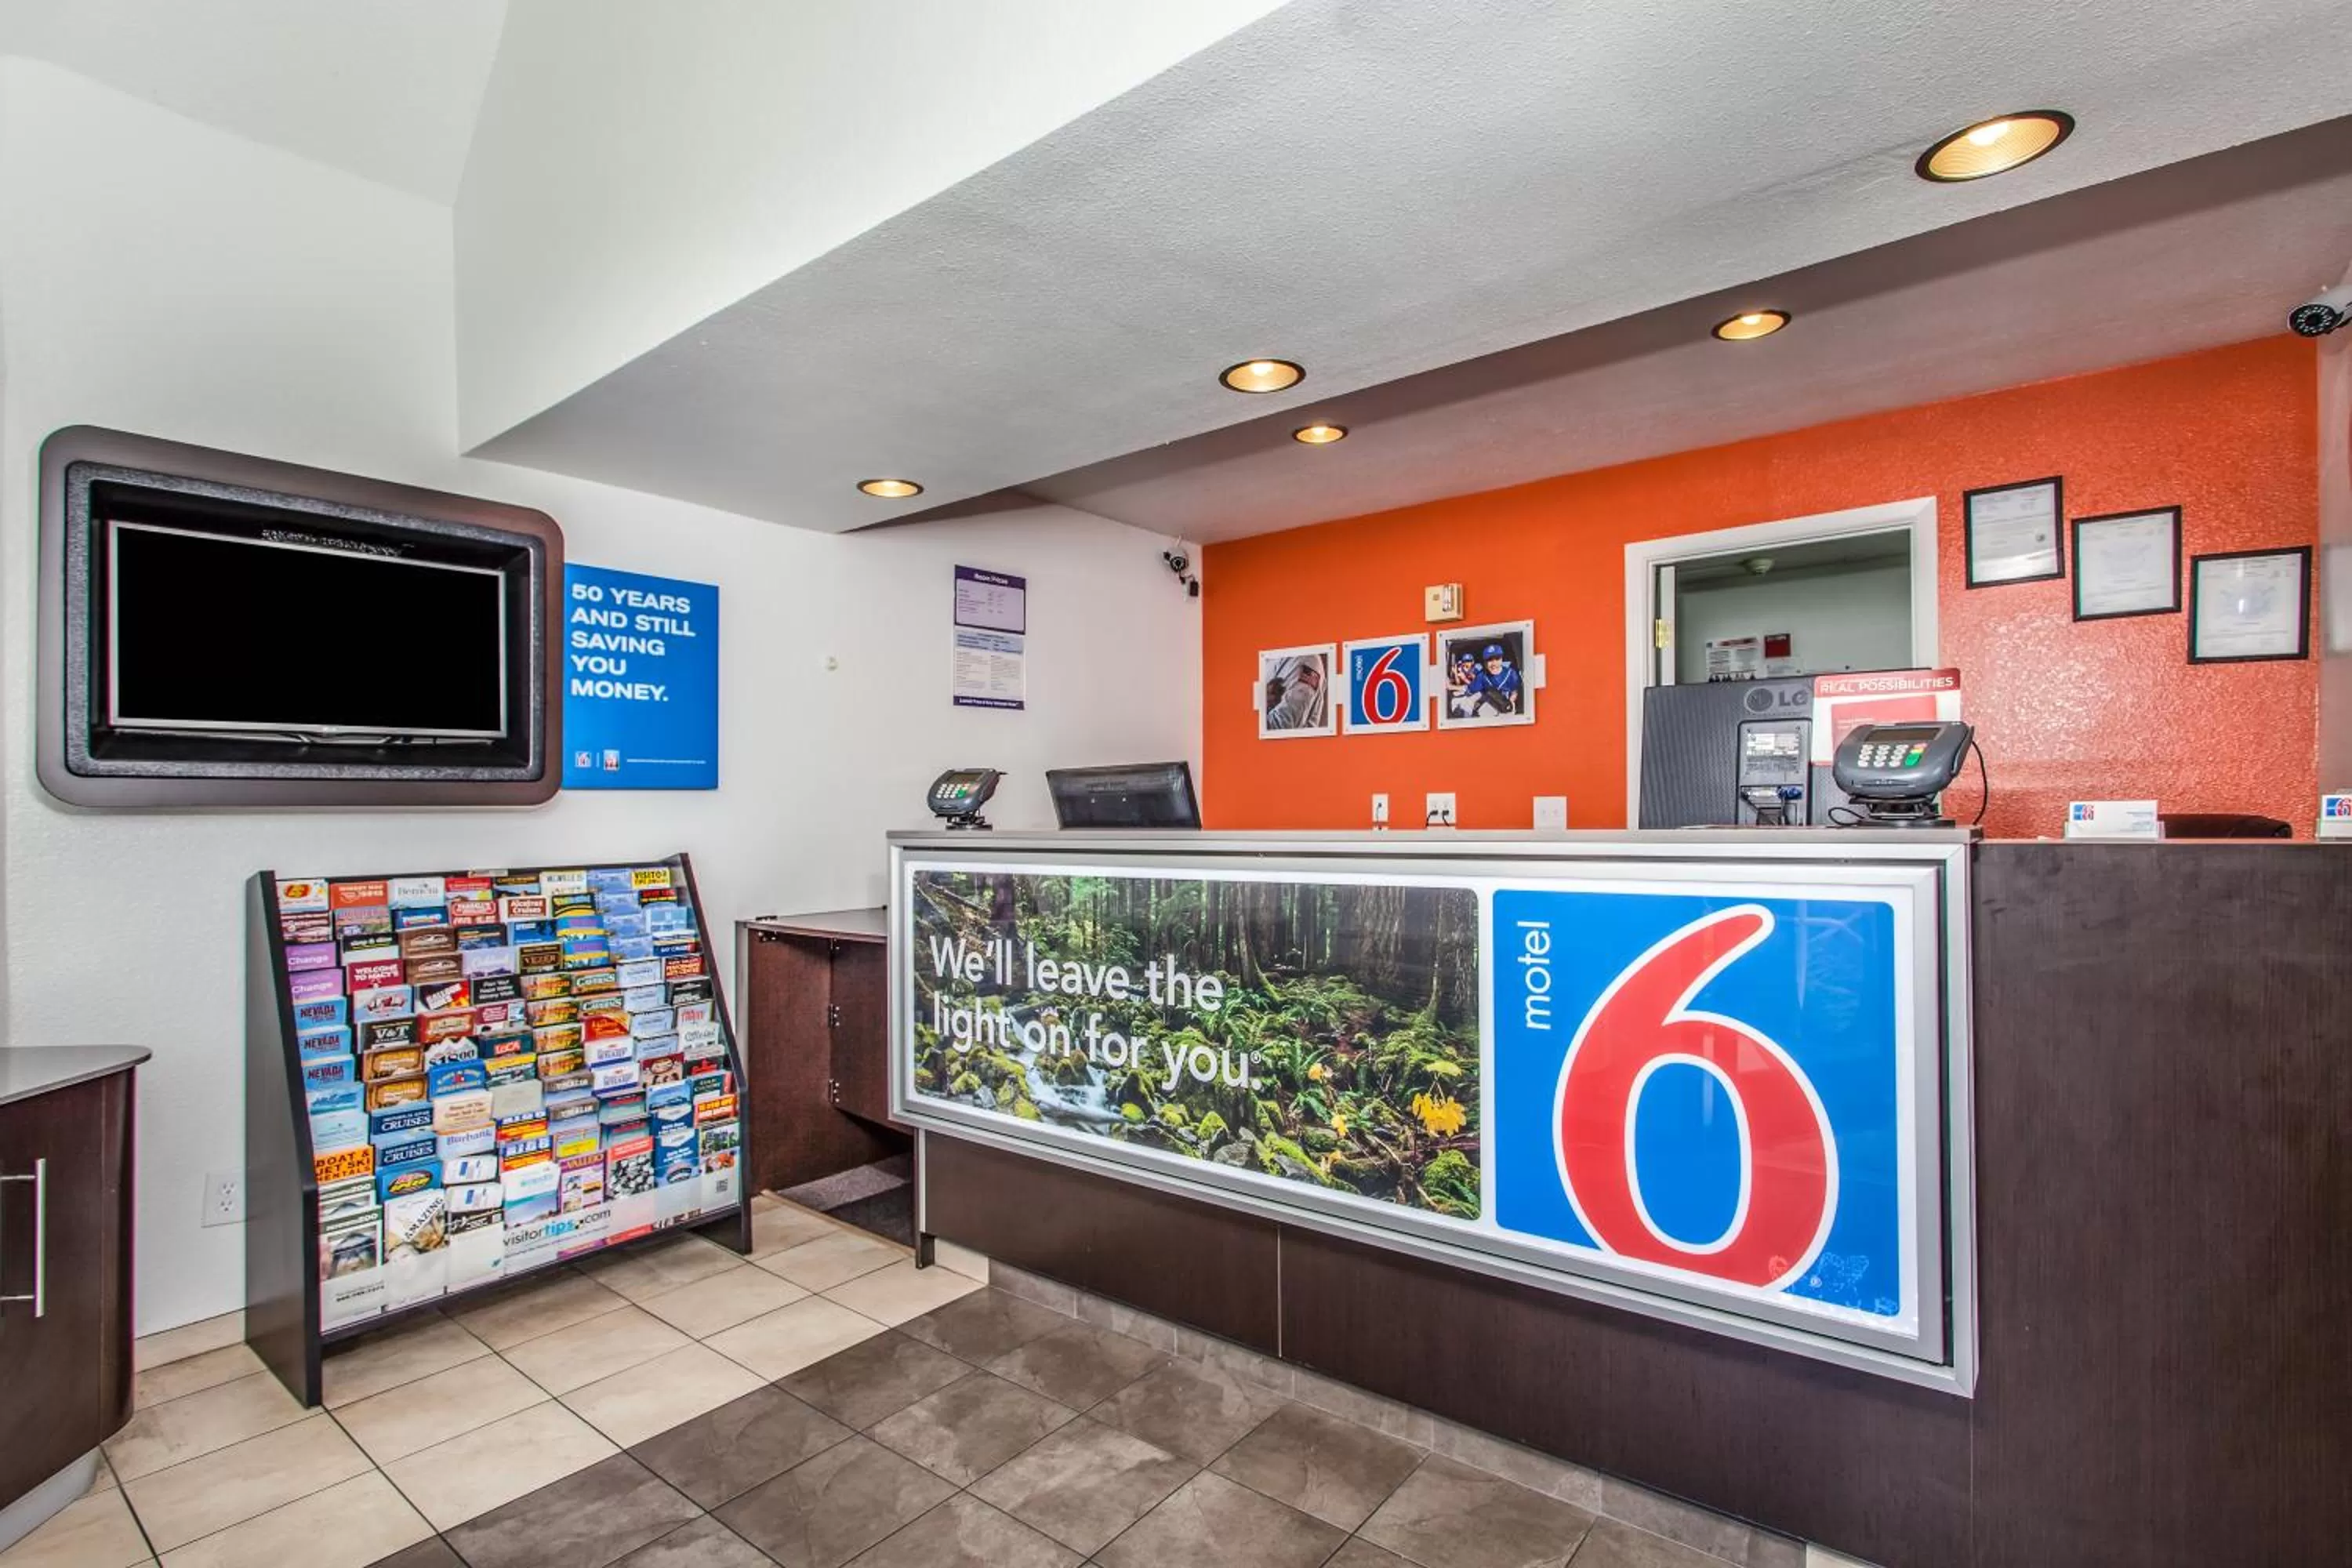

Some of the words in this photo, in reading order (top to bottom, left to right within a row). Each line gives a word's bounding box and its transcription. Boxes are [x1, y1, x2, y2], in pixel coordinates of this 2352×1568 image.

[572, 583, 603, 601] 50
[609, 588, 691, 613] YEARS
[571, 608, 627, 628] AND
[635, 615, 696, 637] STILL
[571, 631, 665, 655] SAVING
[571, 655, 626, 675] YOU
[571, 679, 669, 702] MONEY.
[1362, 647, 1412, 725] 6
[1820, 683, 1854, 693] REAL
[1859, 677, 1955, 691] POSSIBILITIES
[288, 955, 328, 965] Change
[354, 964, 398, 975] WELCOME
[929, 935, 1014, 987] We'll
[1027, 941, 1131, 1000] leave
[1144, 953, 1225, 1011] the
[300, 1004, 336, 1018] NEVADA
[933, 992, 1011, 1054] light
[1023, 1018, 1071, 1057] on
[1084, 1013, 1146, 1069] for
[304, 1035, 339, 1049] NEVADA
[308, 1065, 343, 1080] NEVADA
[1517, 920, 1552, 1030] motel
[1552, 902, 1840, 1291] 6
[382, 1116, 431, 1131] CRUISES
[316, 1152, 355, 1167] BOAT
[384, 1146, 434, 1164] CRUISES
[317, 1163, 343, 1174] JET
[347, 1158, 371, 1168] SKI
[405, 1196, 445, 1240] AMAZING
[503, 1209, 612, 1247] visitortips.com
